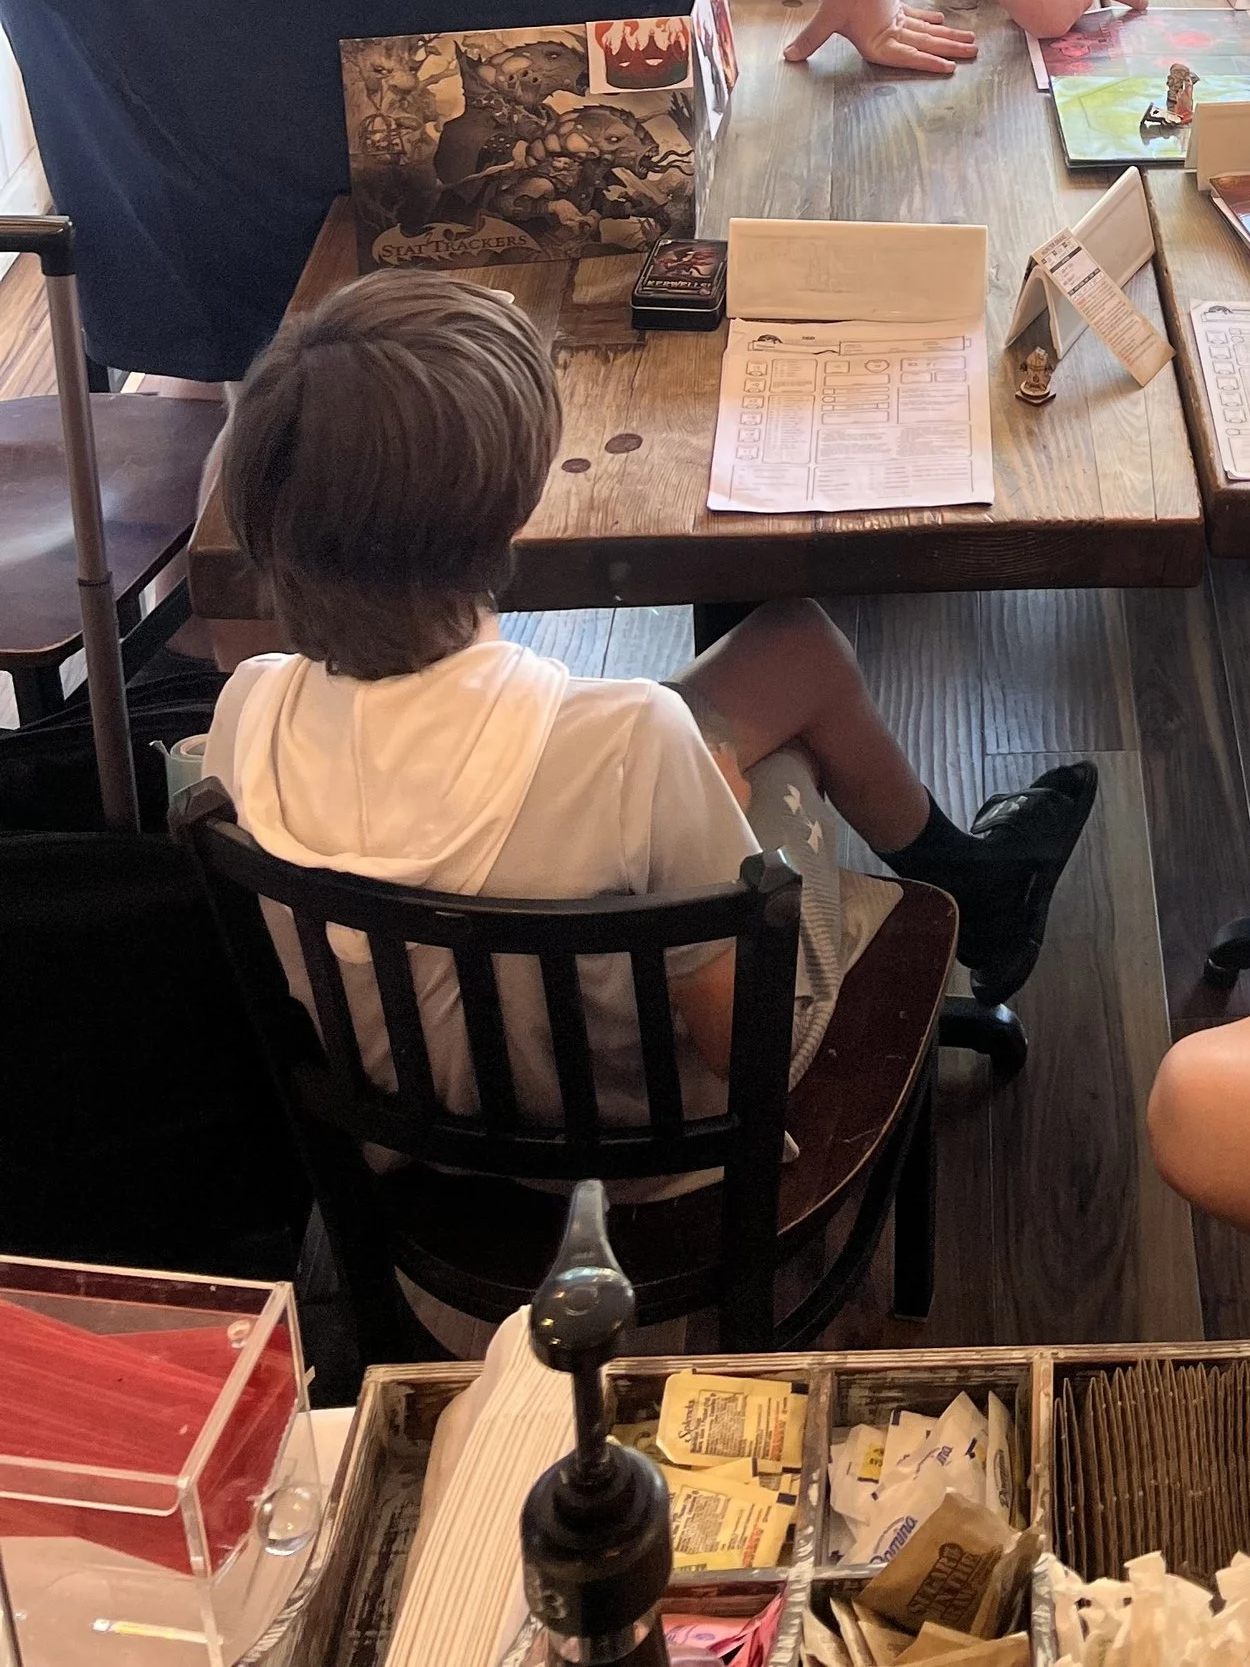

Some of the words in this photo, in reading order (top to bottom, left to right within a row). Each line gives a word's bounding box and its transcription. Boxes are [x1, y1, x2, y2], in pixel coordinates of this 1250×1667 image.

[382, 243, 426, 258] STAT
[433, 234, 528, 253] TRACKERS
[678, 1398, 696, 1443] Splenda
